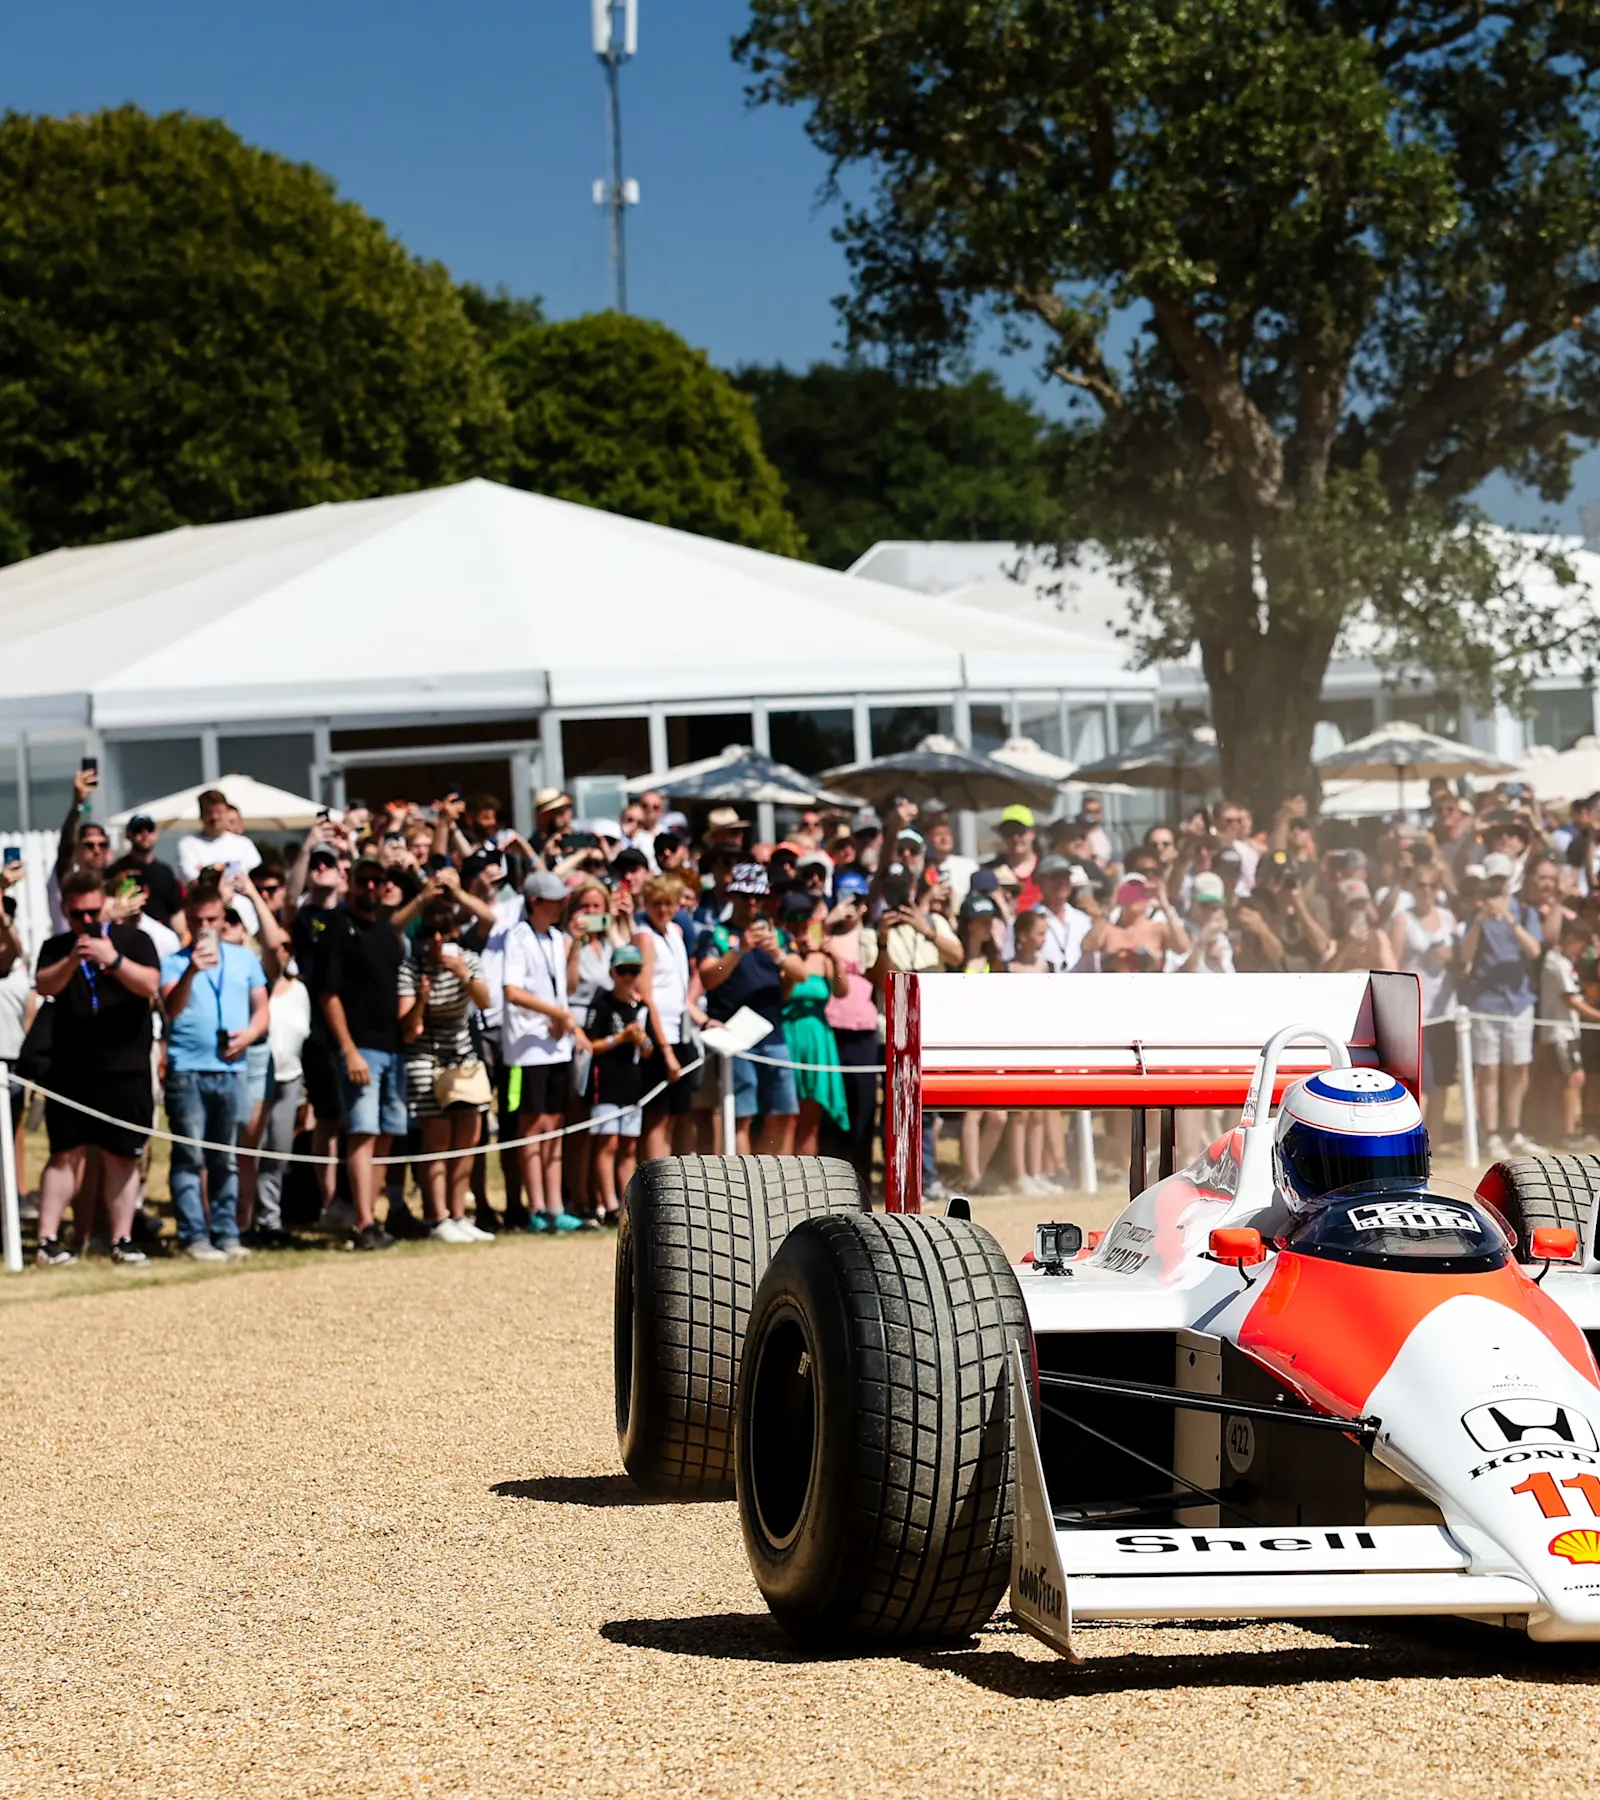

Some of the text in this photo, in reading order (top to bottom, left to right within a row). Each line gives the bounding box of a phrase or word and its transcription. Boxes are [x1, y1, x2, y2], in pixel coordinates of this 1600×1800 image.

[1358, 1214, 1477, 1229] HEUER
[1231, 1424, 1249, 1455] 422
[1115, 1532, 1377, 1553] Shell
